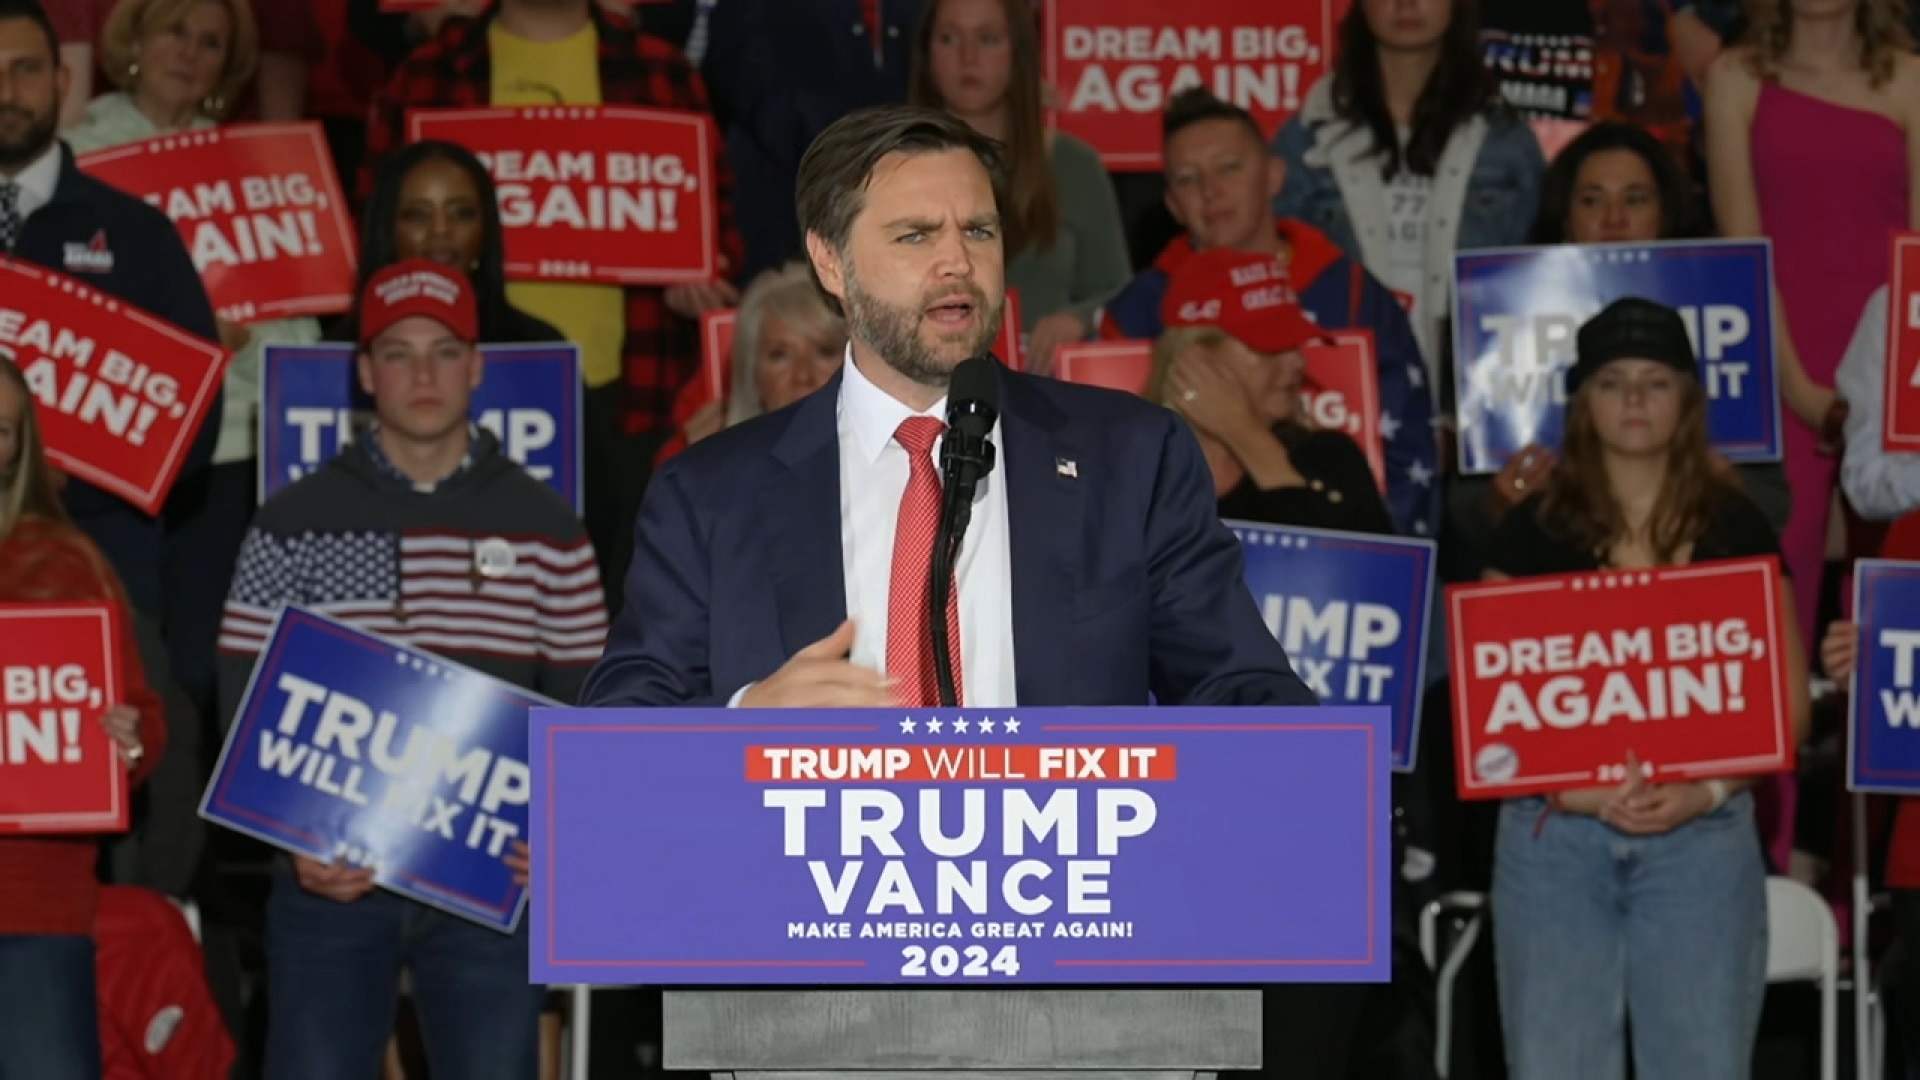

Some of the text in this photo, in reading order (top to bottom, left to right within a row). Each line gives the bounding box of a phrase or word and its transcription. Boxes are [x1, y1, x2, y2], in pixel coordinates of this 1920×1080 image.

[1063, 24, 1321, 64] DREAM BIG,
[240, 172, 328, 211] BIG,
[605, 152, 697, 192] BIG,
[99, 348, 187, 420] BIG,
[1706, 362, 1750, 399] IT
[1473, 618, 1766, 679] DREAM BIG,
[3, 663, 103, 710] BIG,
[1345, 662, 1394, 702] IT
[1484, 660, 1746, 735] AGAIN!
[278, 672, 530, 813] TRUMP
[763, 748, 1158, 780] TRUMP WILL FIX IT
[1596, 760, 1655, 782] 204
[258, 729, 369, 806] WILL
[465, 812, 519, 857] IT
[763, 788, 1158, 857] TRUMP
[807, 859, 1112, 916] VANCE
[787, 922, 1133, 938] MAKE AMERICA GREAT AGAIN!
[901, 945, 1021, 977] 2024
